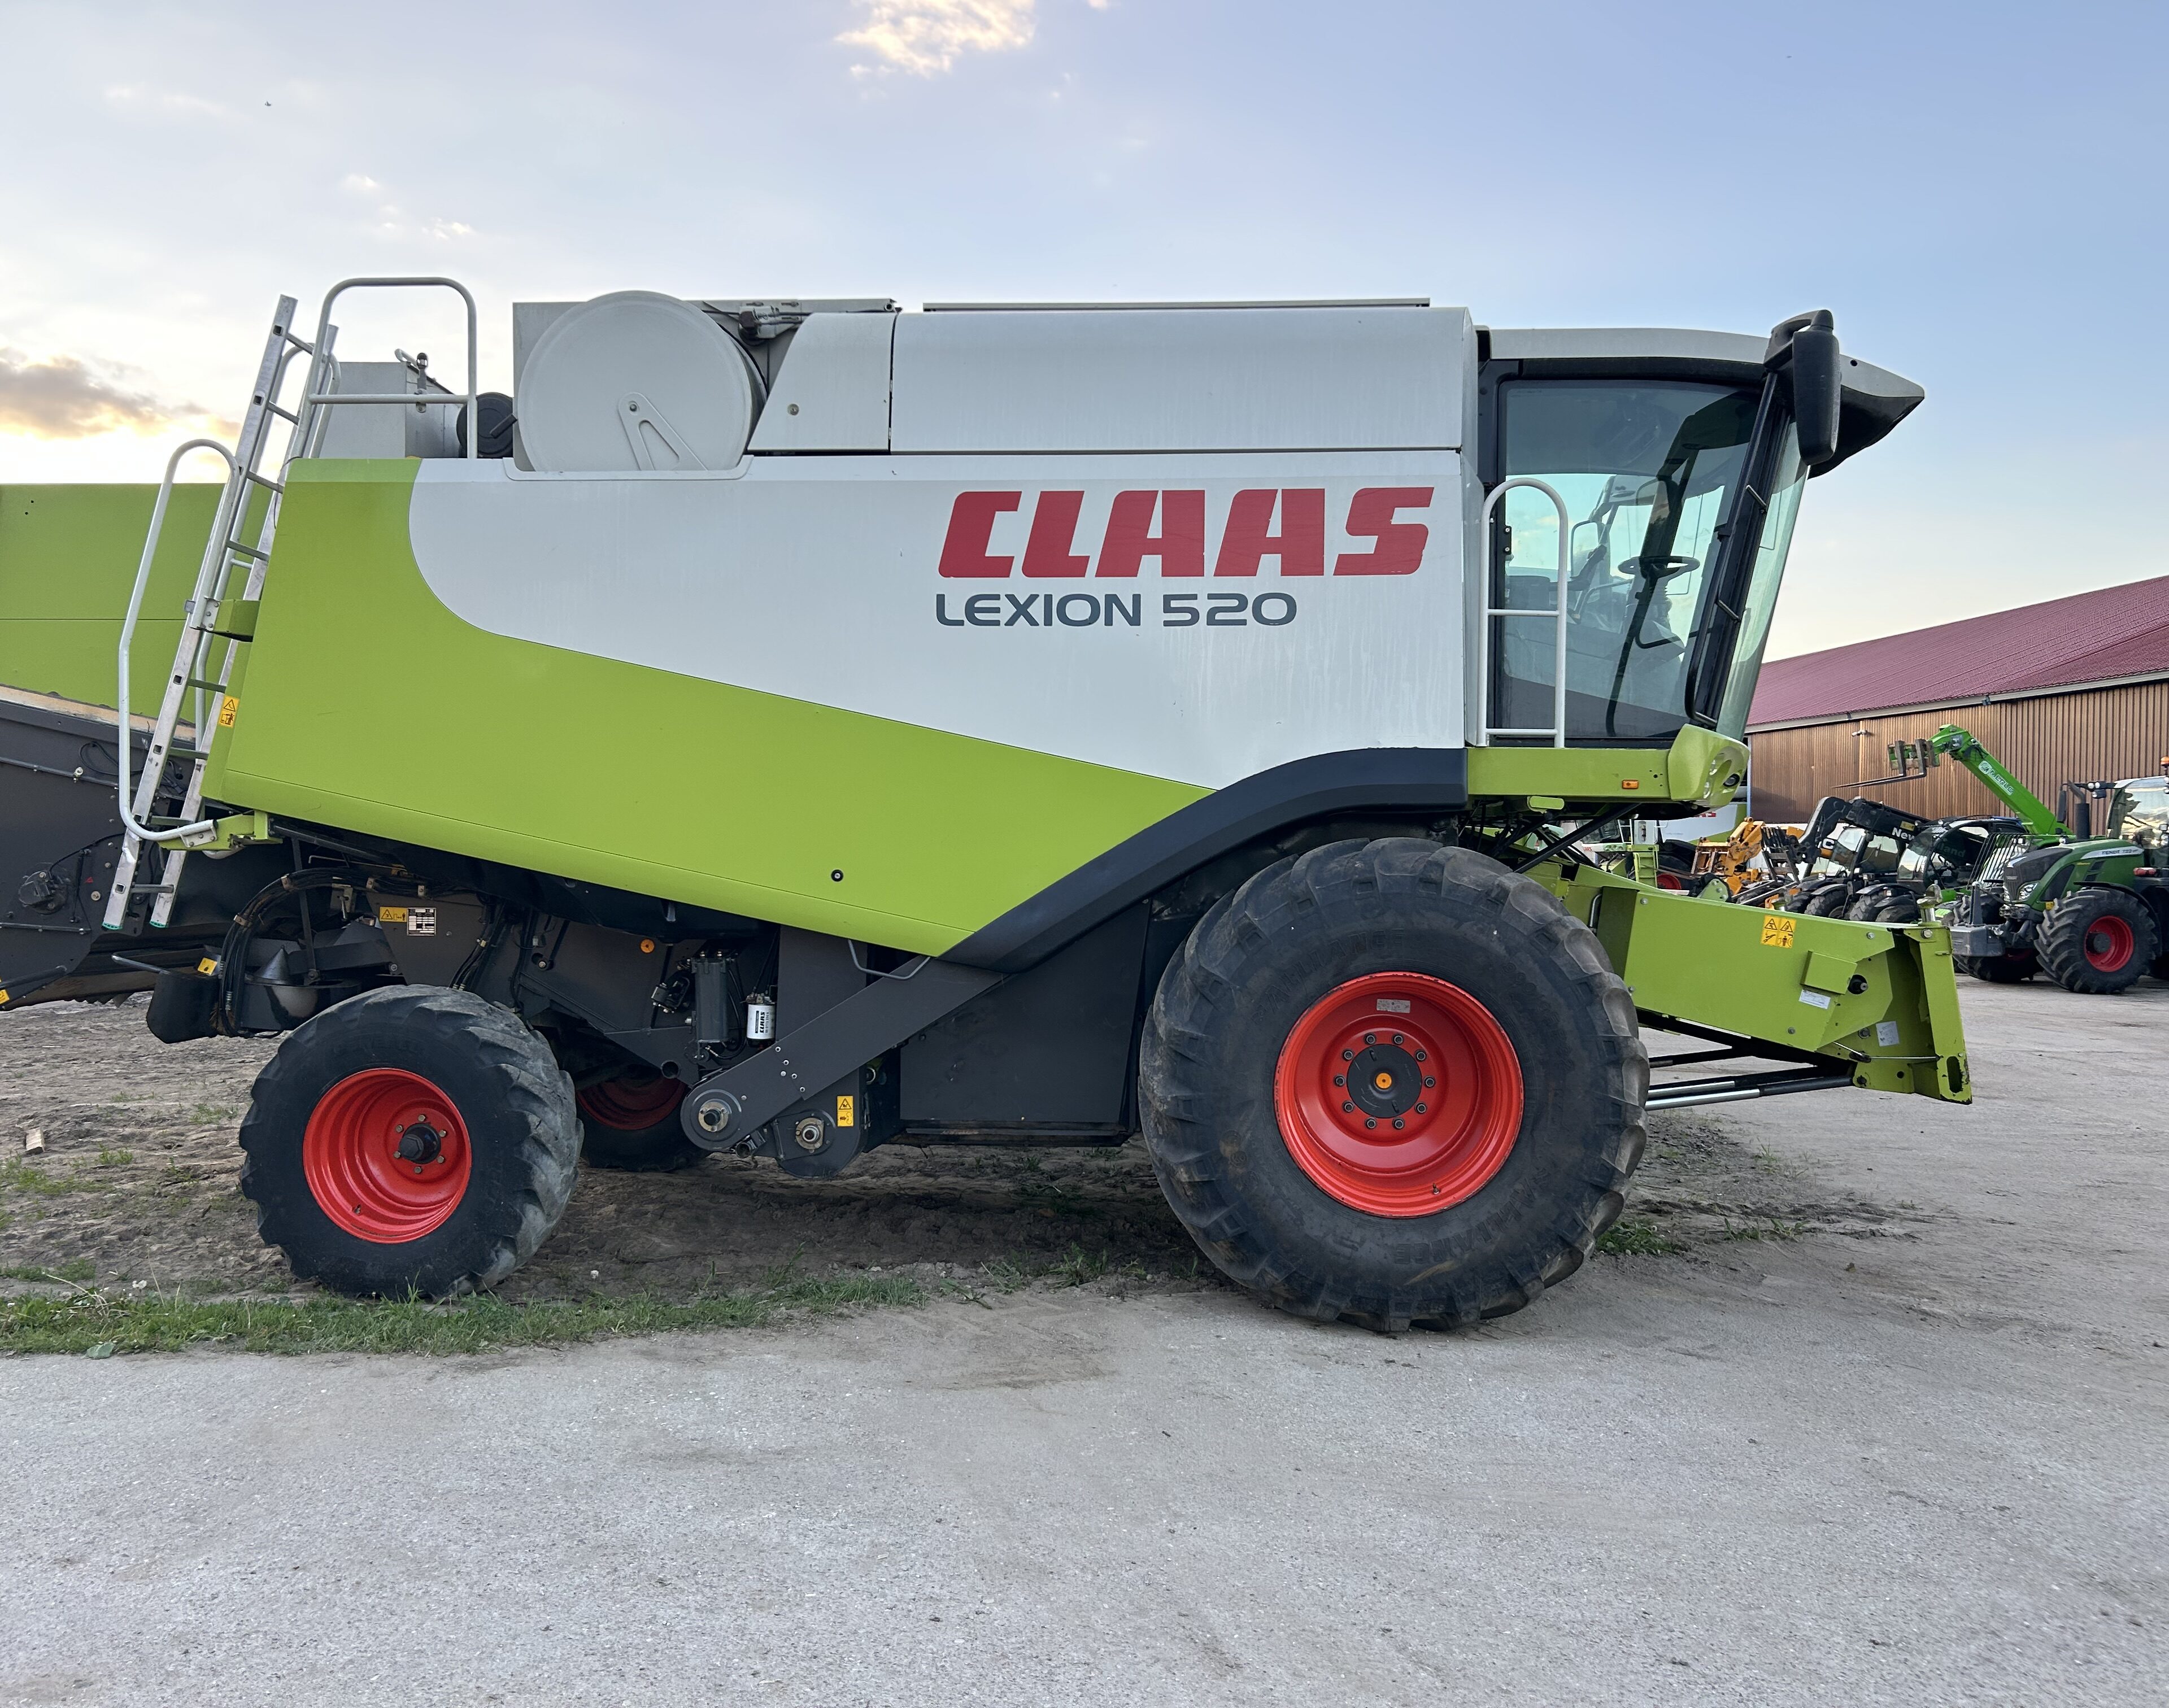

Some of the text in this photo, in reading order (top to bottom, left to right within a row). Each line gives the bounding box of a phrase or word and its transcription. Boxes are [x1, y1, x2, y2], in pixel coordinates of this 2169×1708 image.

[938, 487, 1434, 577] CLAAS
[936, 592, 1297, 627] LEXION 520
[1266, 927, 1404, 1015] ALLIANCE
[1393, 1178, 1536, 1265] ALLIANCE
